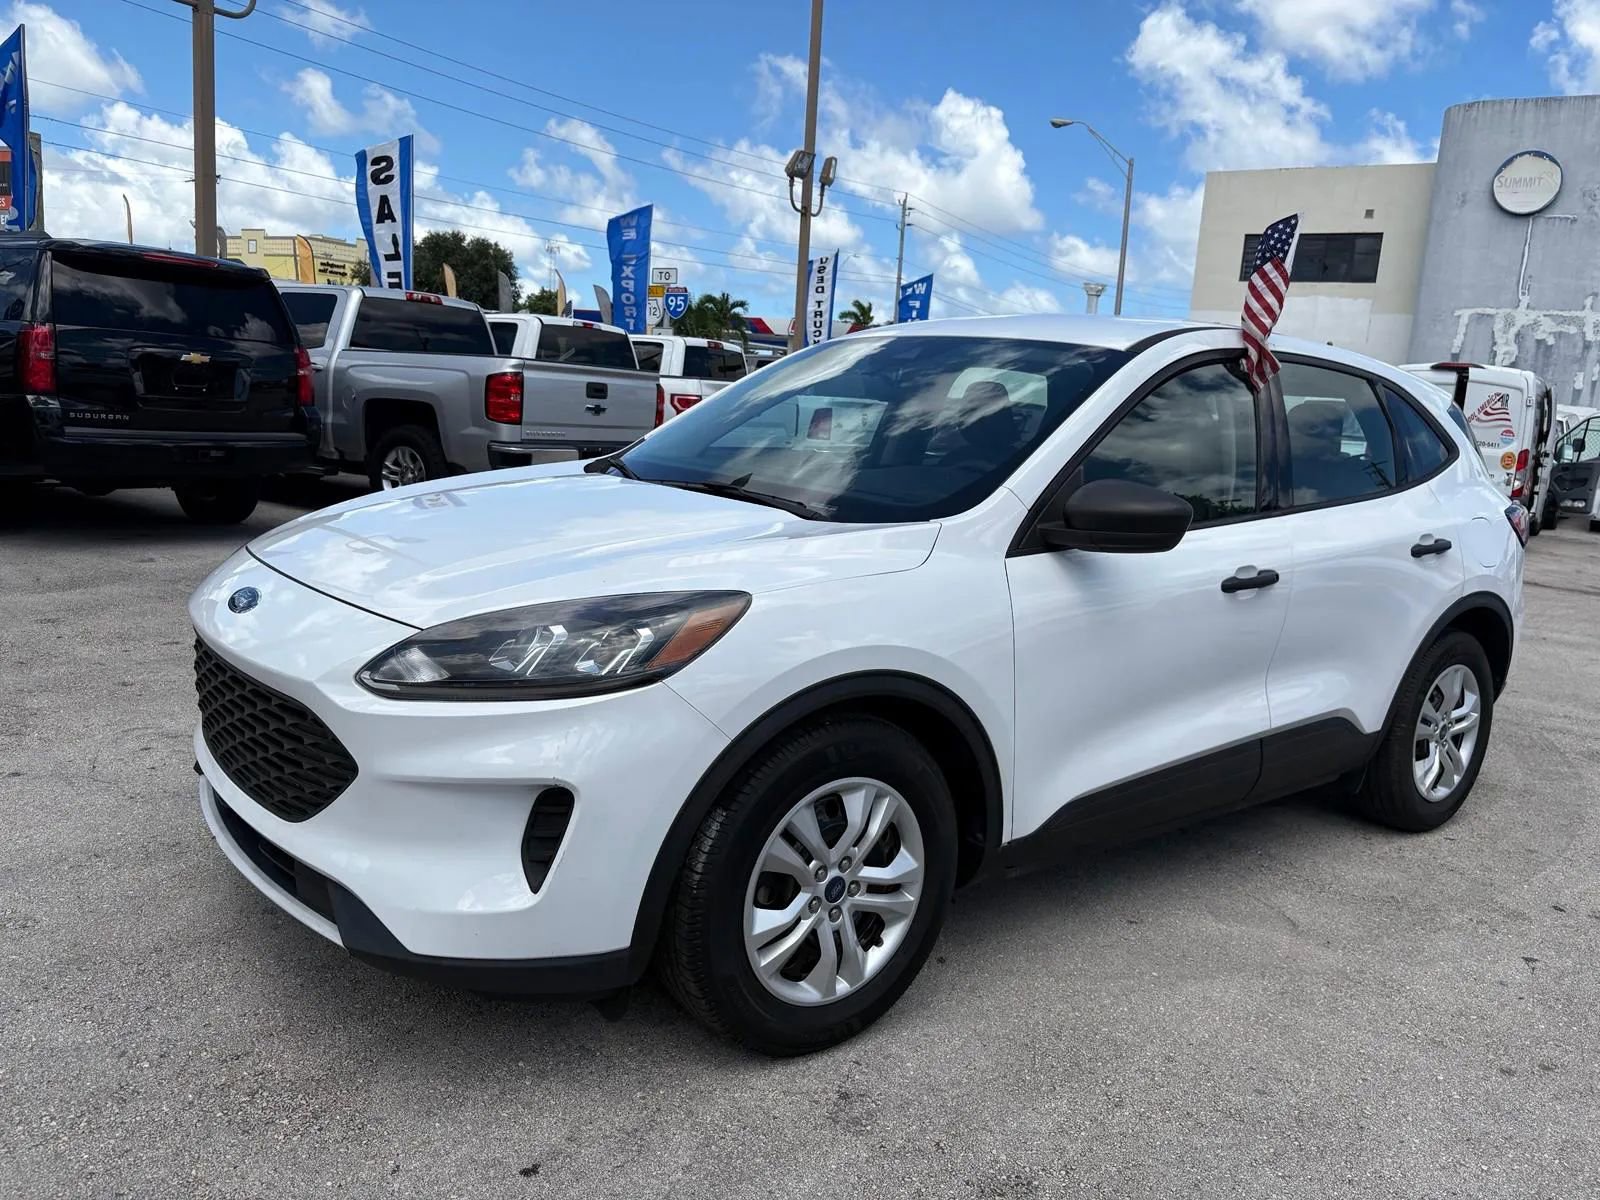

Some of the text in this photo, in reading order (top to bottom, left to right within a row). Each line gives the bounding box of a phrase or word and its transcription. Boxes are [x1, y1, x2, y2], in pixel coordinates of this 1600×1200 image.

[1496, 175, 1544, 189] SUMMIT
[658, 271, 671, 281] TO
[668, 296, 685, 311] 95
[69, 412, 130, 420] SUBURBAN
